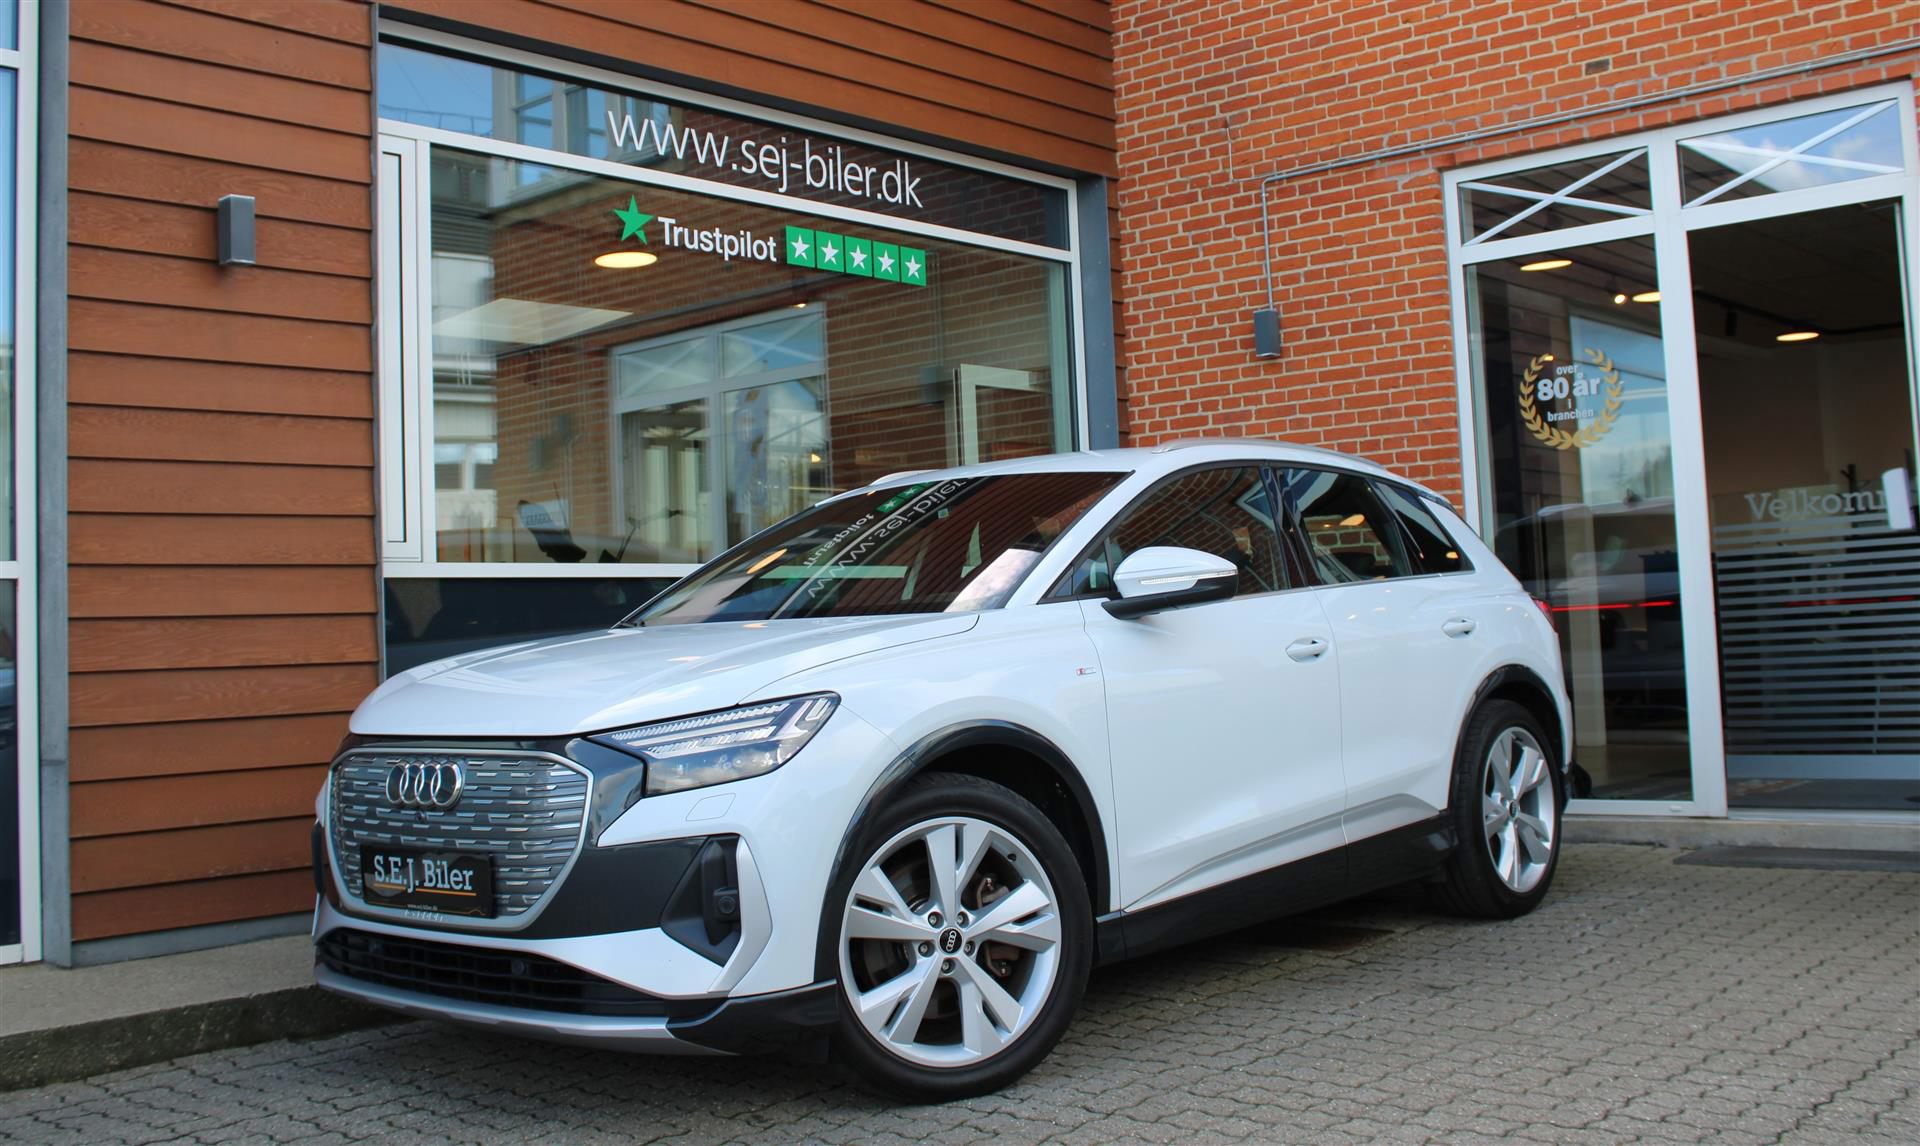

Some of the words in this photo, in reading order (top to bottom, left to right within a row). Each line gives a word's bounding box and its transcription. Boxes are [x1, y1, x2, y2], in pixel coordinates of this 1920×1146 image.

[607, 110, 924, 208] www.sej-biler.dk
[657, 216, 778, 262] Trustpilot
[1537, 377, 1570, 401] 80
[1573, 372, 1600, 396] år
[1556, 365, 1578, 375] over
[1547, 408, 1594, 422] branchen
[374, 855, 419, 893] S.E.J.
[422, 859, 473, 890] Biler
